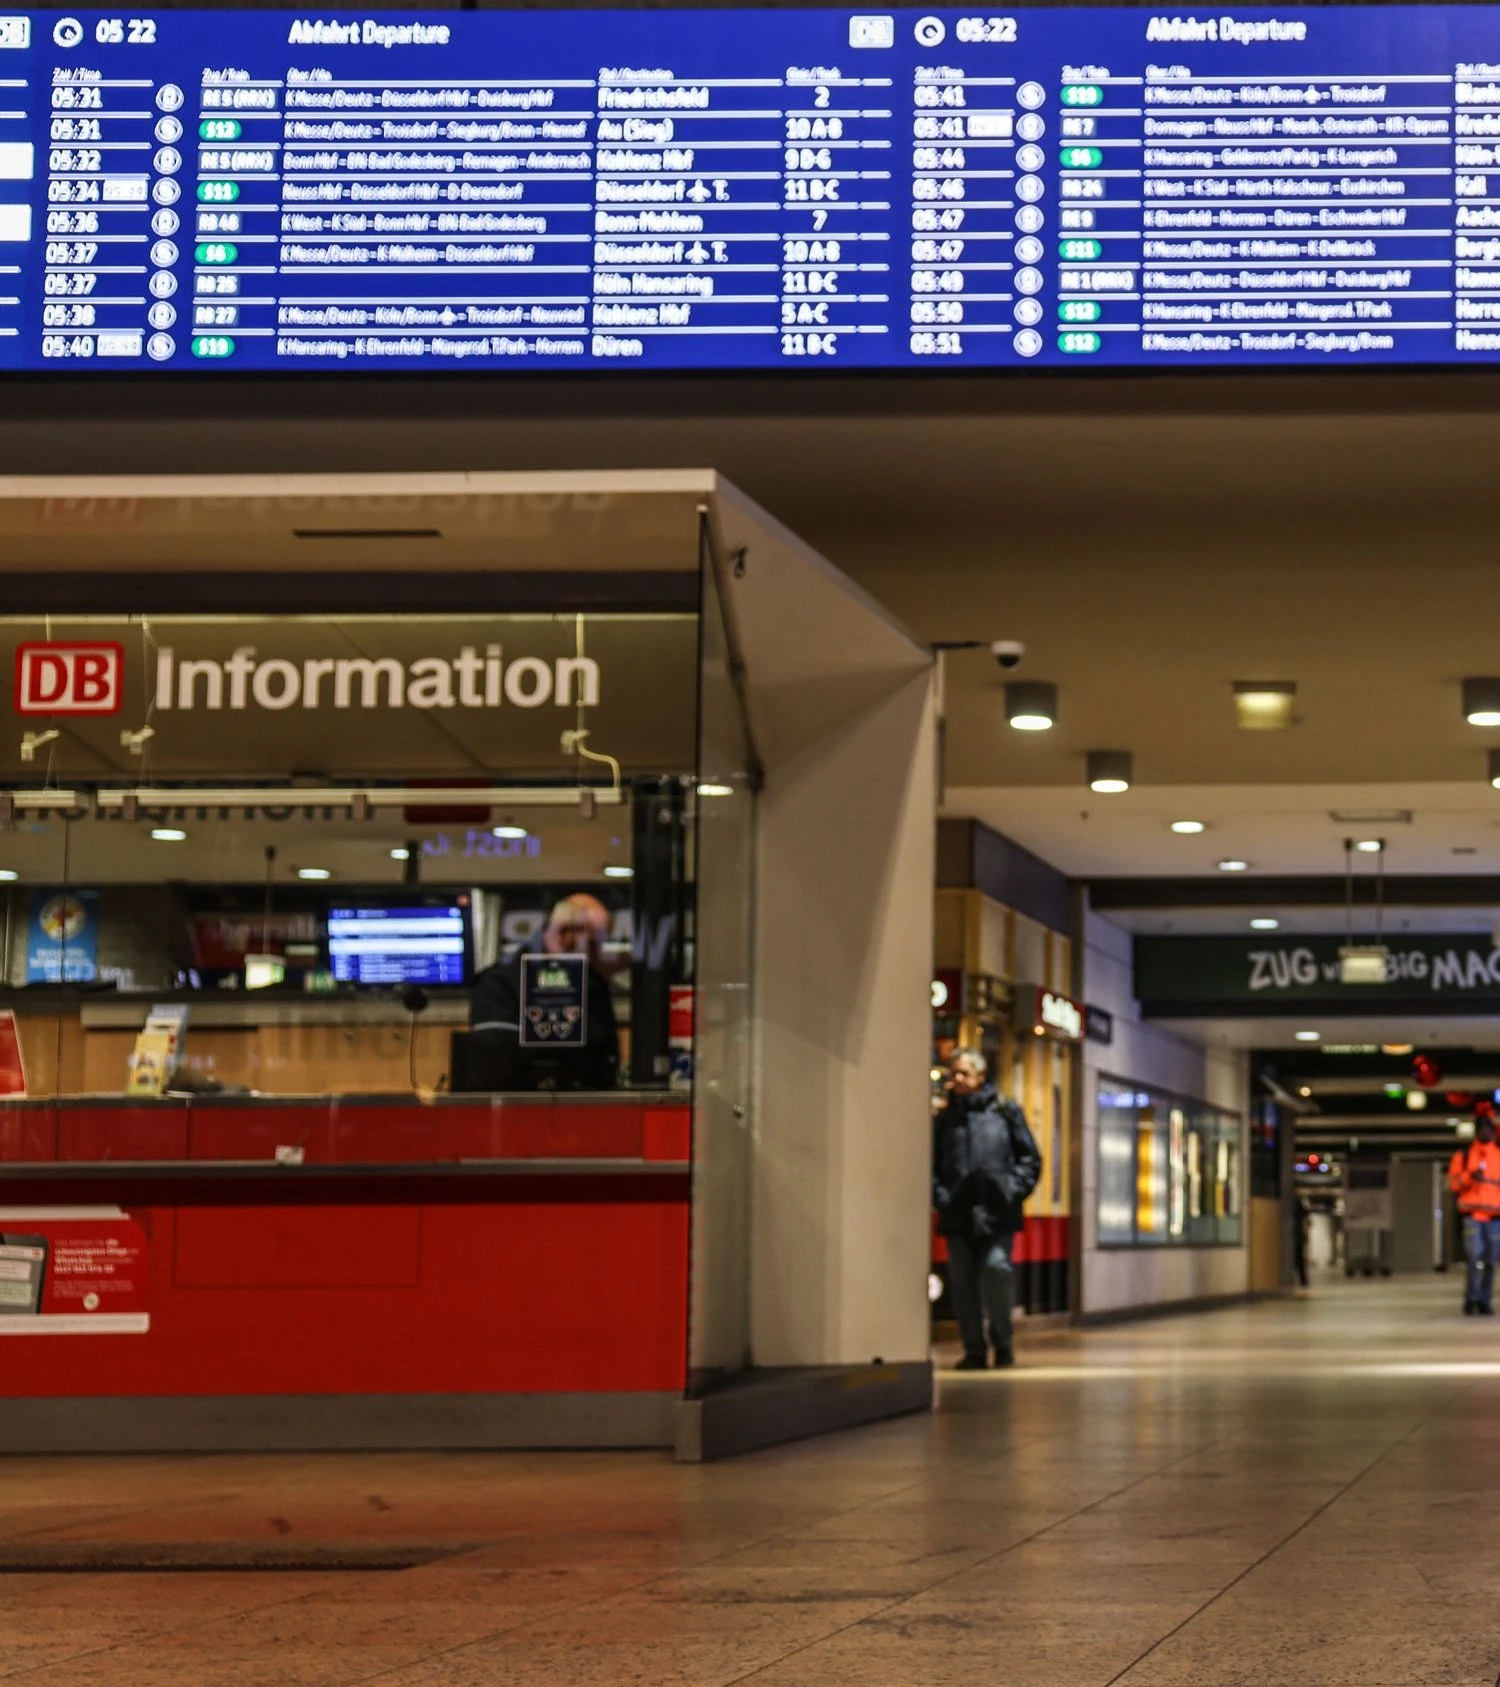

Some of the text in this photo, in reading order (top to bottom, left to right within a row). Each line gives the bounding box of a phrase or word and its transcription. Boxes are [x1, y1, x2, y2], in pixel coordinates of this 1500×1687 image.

[96, 20, 156, 43] 05 22
[288, 20, 450, 48] Abfahrt Departure
[956, 18, 1017, 42] 05:22
[1146, 17, 1306, 44] Abfahrt Departure
[52, 88, 102, 108] 05:31
[815, 86, 829, 107] 2
[914, 86, 966, 106] 05:41
[51, 119, 101, 139] 05:31
[207, 117, 235, 138] S12
[598, 116, 674, 141] Au (Sieg)
[786, 118, 810, 139] 10
[914, 116, 965, 138] 05:41
[50, 150, 100, 170] 05:32
[597, 148, 693, 170] Koblenz Hbf
[785, 149, 799, 169] 9
[48, 181, 99, 201] 05:34
[205, 183, 232, 199] S11
[596, 180, 685, 201] Düsseldorf
[785, 179, 809, 200] 11
[1456, 176, 1486, 195] Kall
[47, 212, 98, 232] 05:36
[813, 208, 827, 230] 7
[46, 243, 97, 263] 05:37
[206, 245, 226, 261] S6
[594, 240, 684, 263] Düsseldorf
[783, 241, 808, 262] 10
[45, 274, 96, 294] 05:37
[594, 270, 713, 296] Köln Hansaring
[783, 270, 807, 292] 11
[44, 305, 95, 325] 05:38
[593, 302, 690, 324] Koblenz Hbf
[43, 336, 93, 357] 05:40
[592, 333, 642, 356] Düren
[782, 332, 806, 355] 11
[911, 333, 962, 354] 05:51
[26, 646, 600, 709] DB Information
[1248, 949, 1316, 991] ZUG
